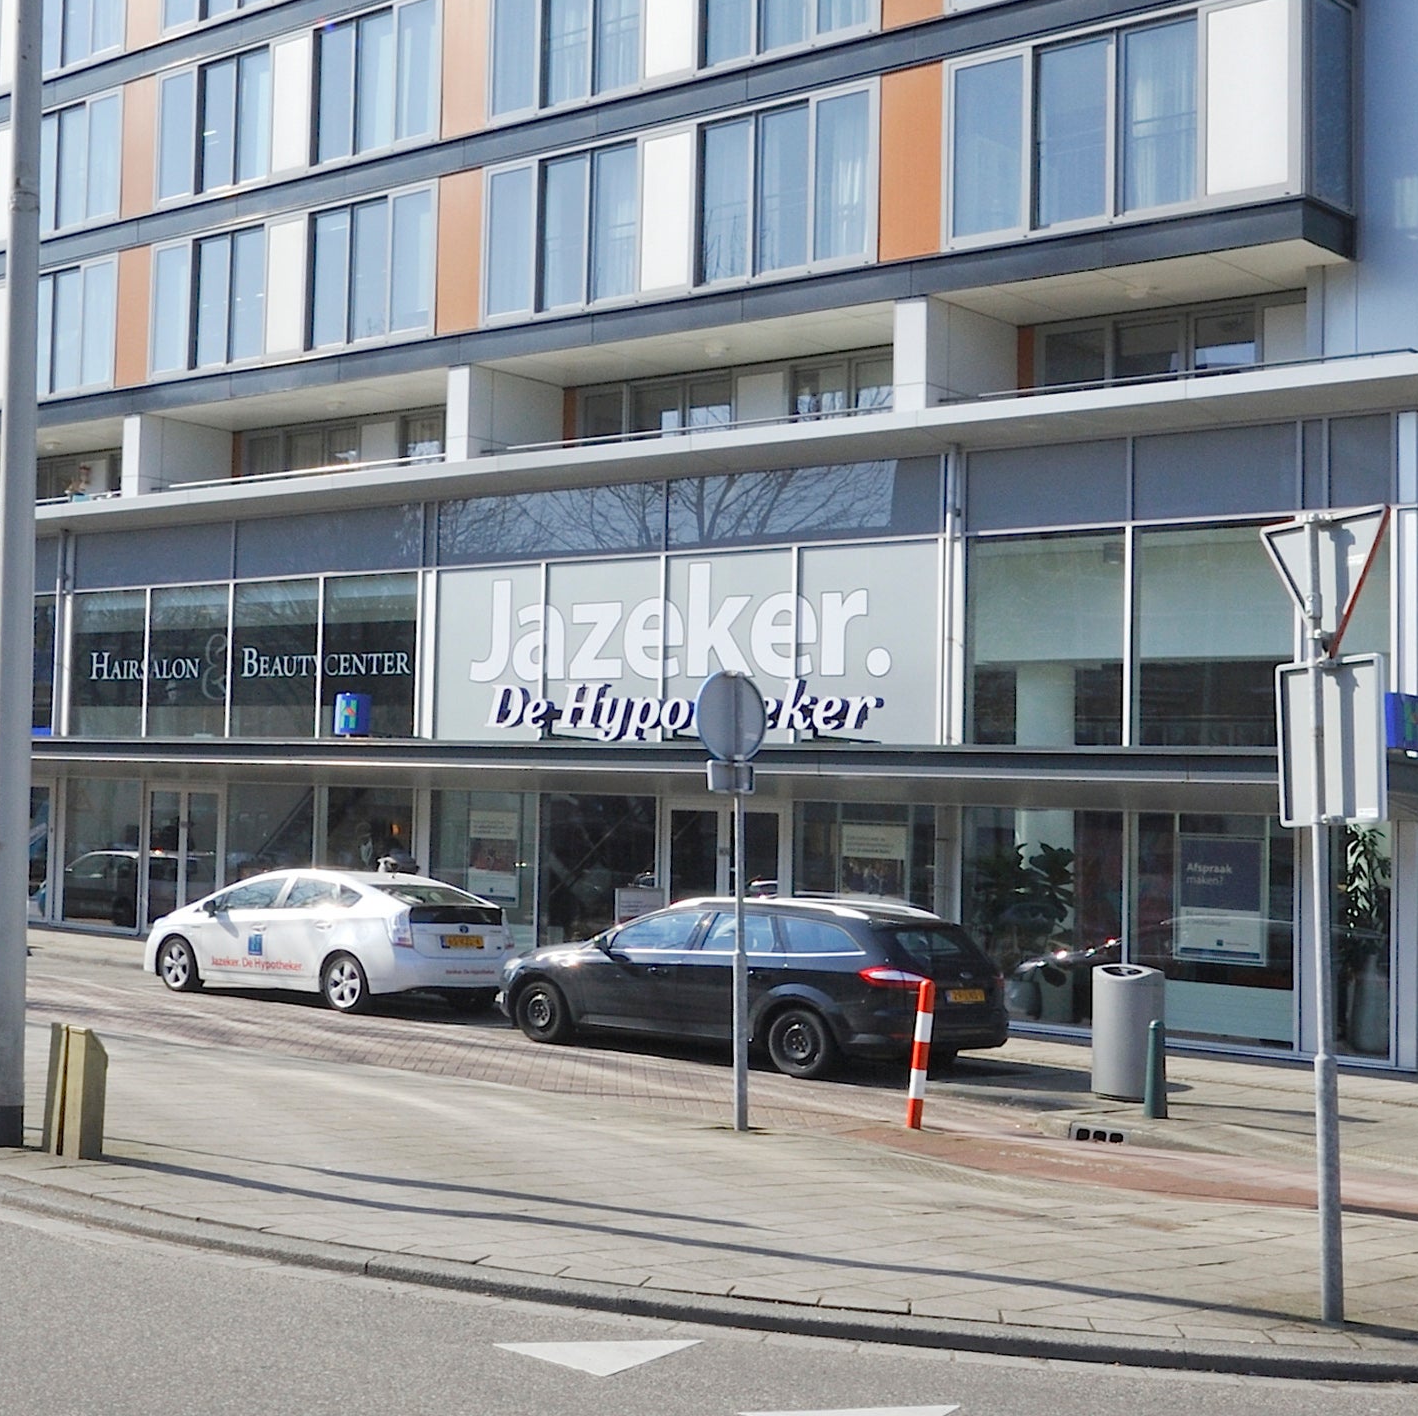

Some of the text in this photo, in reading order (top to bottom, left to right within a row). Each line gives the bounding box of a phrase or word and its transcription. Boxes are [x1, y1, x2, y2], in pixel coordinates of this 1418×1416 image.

[469, 562, 893, 682] Jazeker.
[484, 678, 885, 741] De Hypoker
[1186, 863, 1232, 874] Afspraak
[1186, 876, 1223, 884] maken?
[242, 957, 253, 967] De
